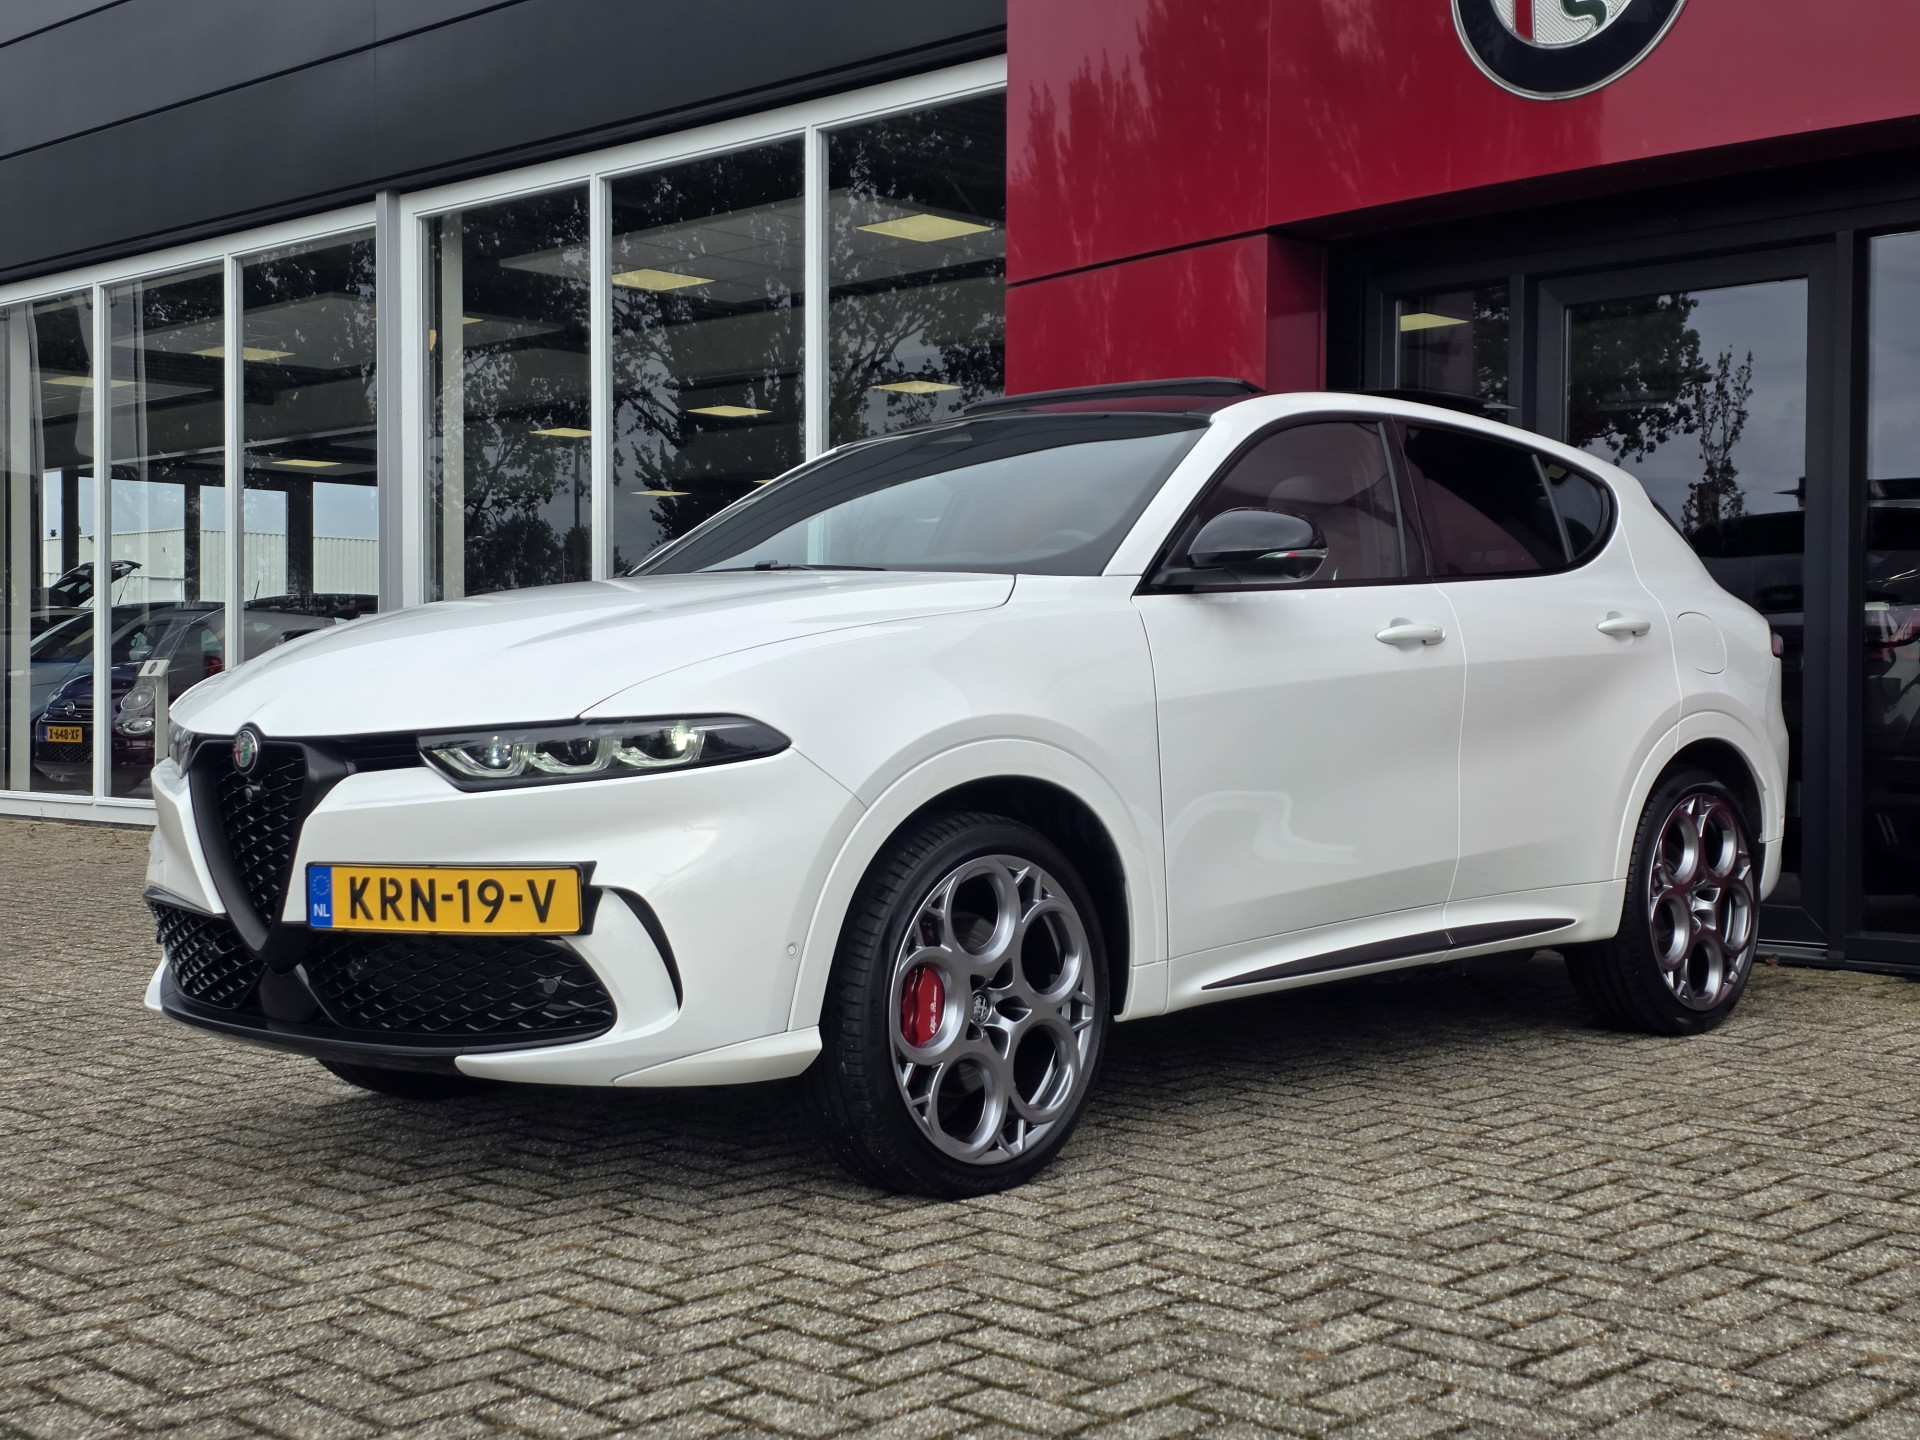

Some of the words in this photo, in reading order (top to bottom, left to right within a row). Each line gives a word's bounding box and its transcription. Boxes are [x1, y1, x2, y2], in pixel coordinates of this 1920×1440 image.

[49, 728, 80, 740] X-648-XF
[349, 876, 556, 923] KRN-19-V
[313, 903, 330, 917] NL
